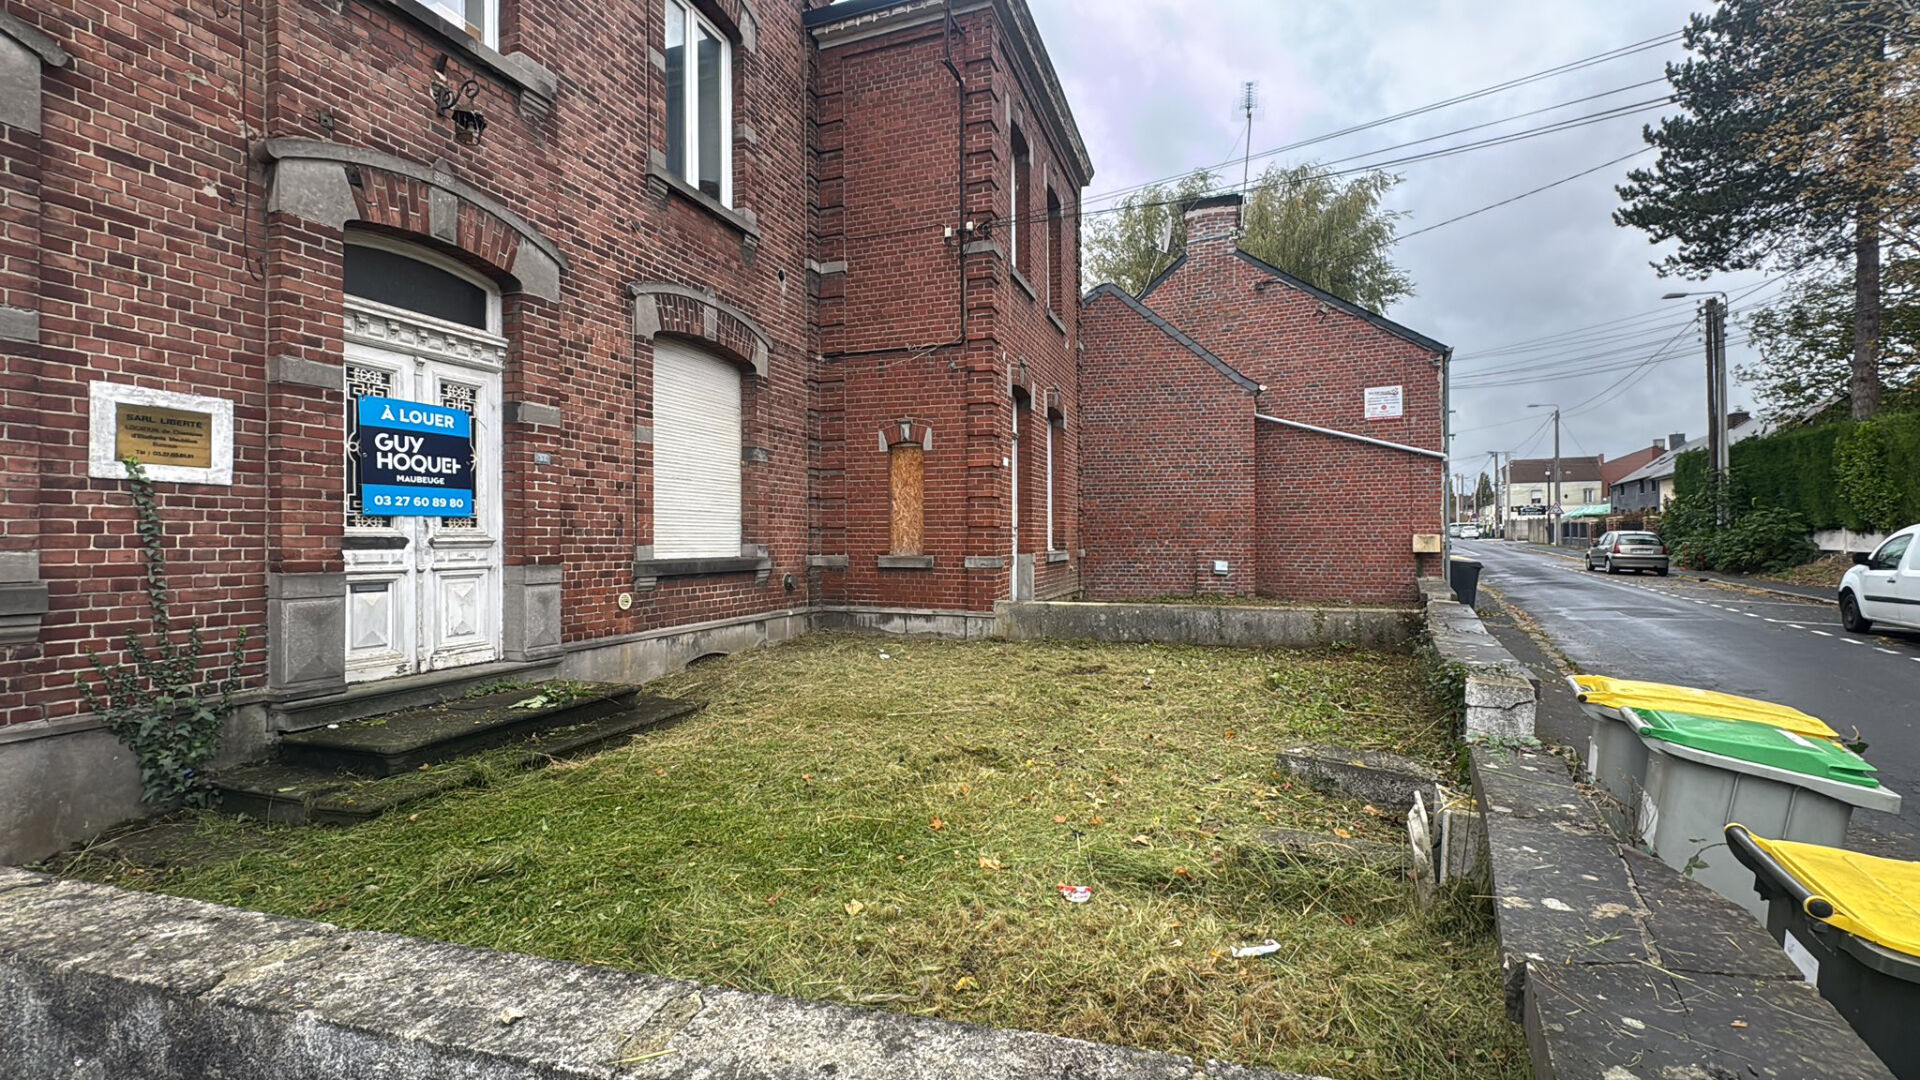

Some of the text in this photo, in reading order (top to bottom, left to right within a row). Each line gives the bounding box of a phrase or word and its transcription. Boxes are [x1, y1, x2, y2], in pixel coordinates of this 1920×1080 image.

[126, 413, 157, 424] SARL
[380, 404, 455, 429] À LOUER
[374, 432, 425, 454] GUY
[376, 451, 462, 475] HOQUET
[396, 474, 446, 485] MAUBEUGE
[374, 495, 464, 508] 03 27 60 89 80
